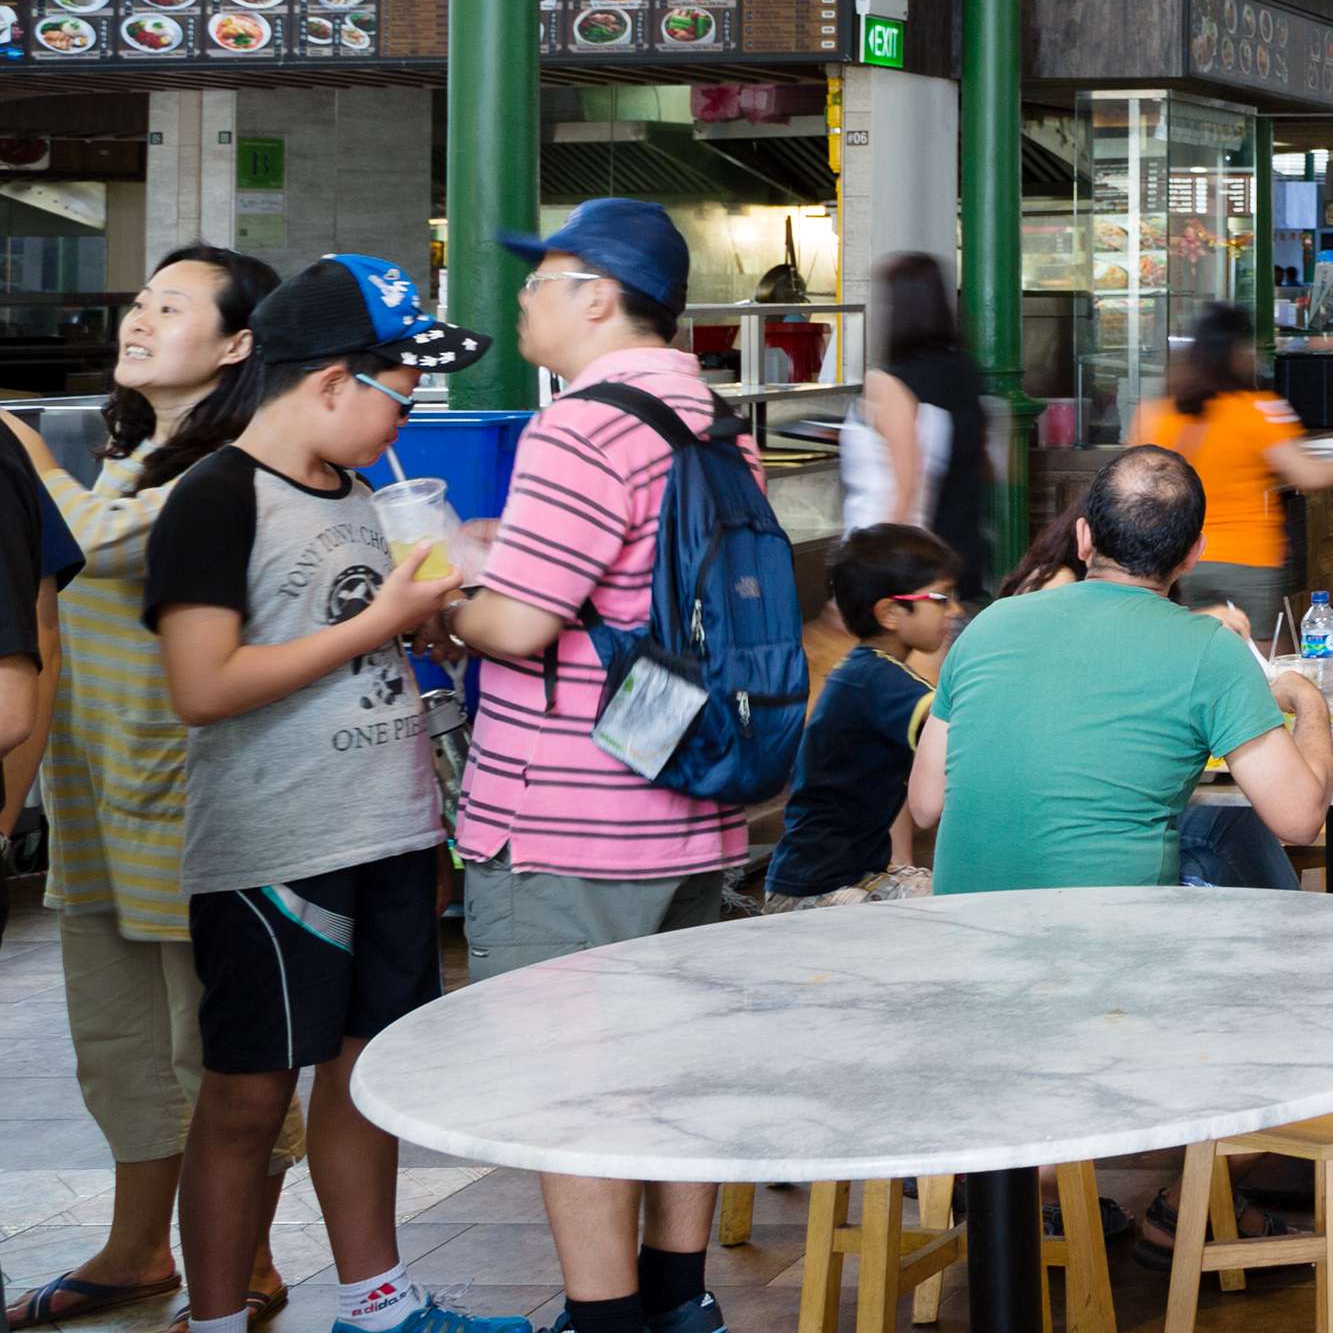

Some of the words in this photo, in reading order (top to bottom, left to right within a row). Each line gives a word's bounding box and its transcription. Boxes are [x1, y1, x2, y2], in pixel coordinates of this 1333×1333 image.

[874, 25, 899, 58] EXIT
[847, 132, 868, 145] #06
[332, 722, 388, 751] ONE
[352, 1291, 408, 1317] adidas
